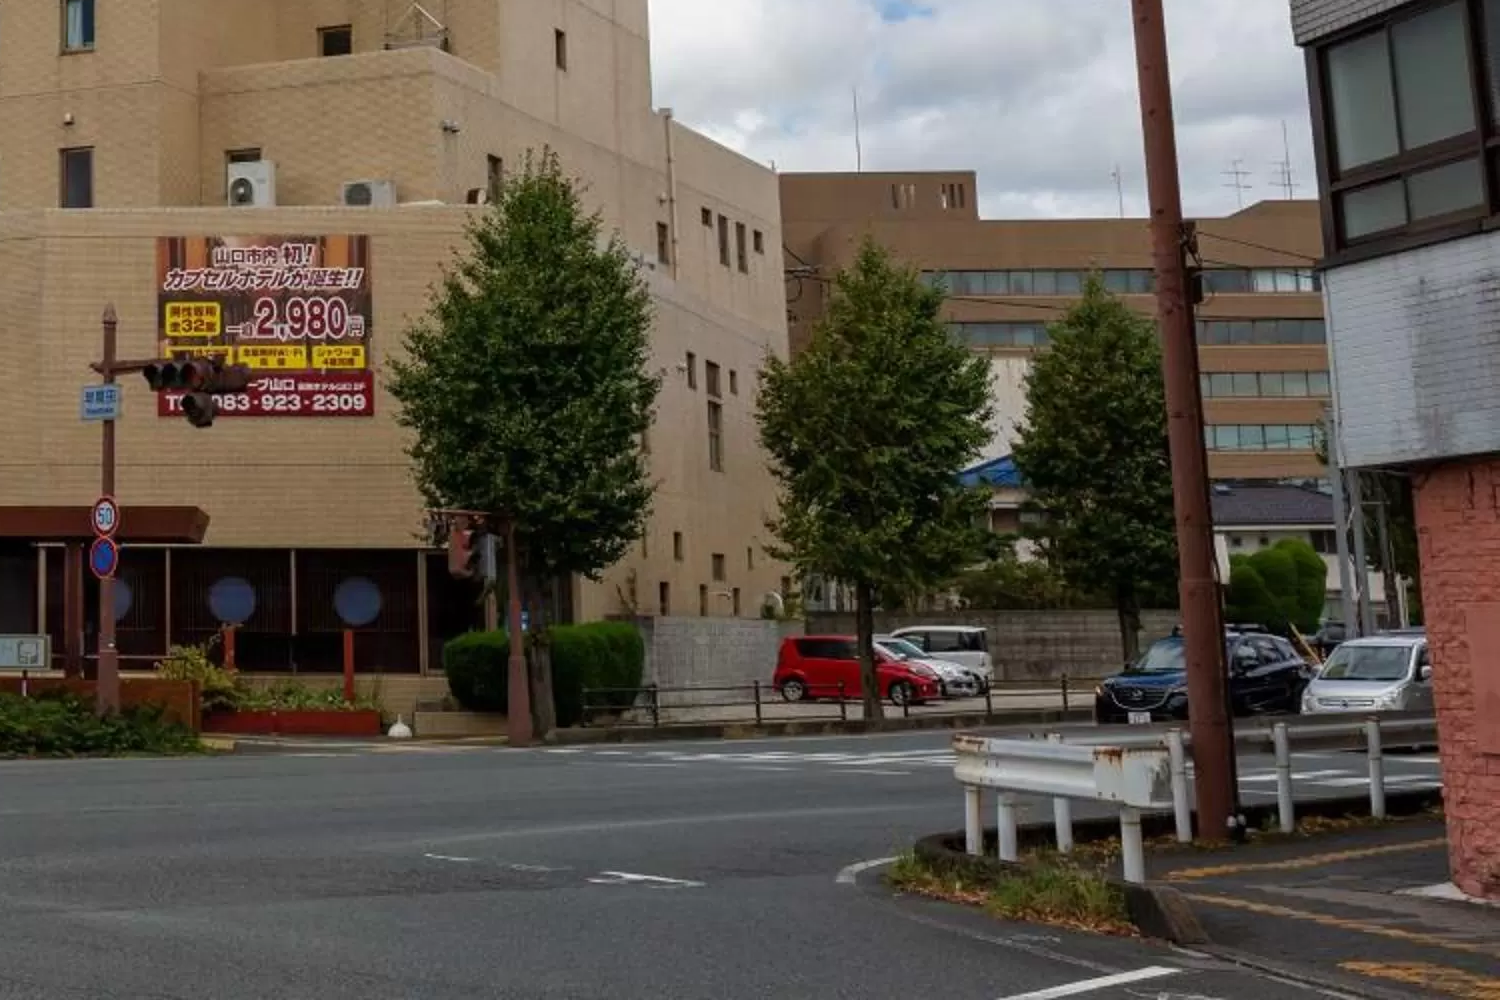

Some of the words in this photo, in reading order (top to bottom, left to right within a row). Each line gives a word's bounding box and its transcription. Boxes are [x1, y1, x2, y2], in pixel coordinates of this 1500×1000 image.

[215, 246, 278, 264] 山口市内
[98, 507, 112, 525] 50
